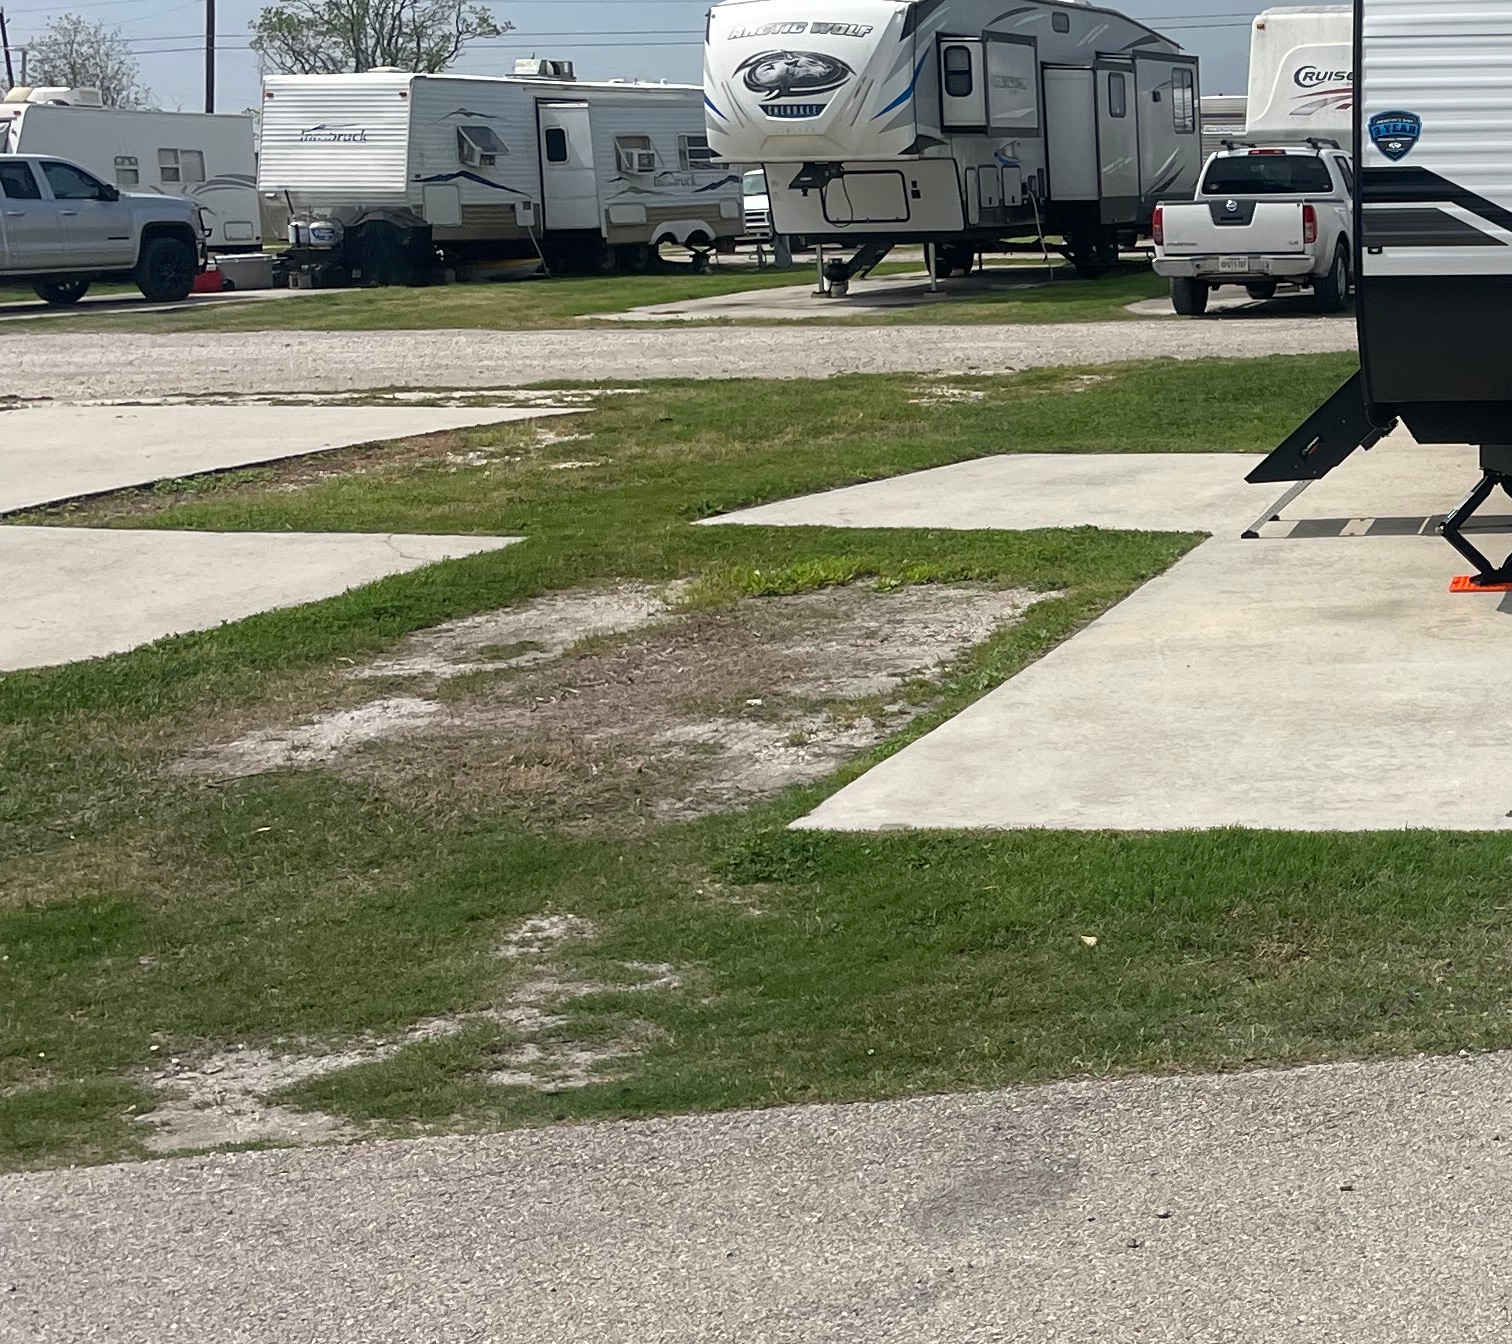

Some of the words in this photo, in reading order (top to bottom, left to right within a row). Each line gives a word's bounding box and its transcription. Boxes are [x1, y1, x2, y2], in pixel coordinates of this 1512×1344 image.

[727, 22, 808, 40] ARCTIC
[810, 21, 873, 38] WOLF
[1383, 123, 1417, 135] YEAR
